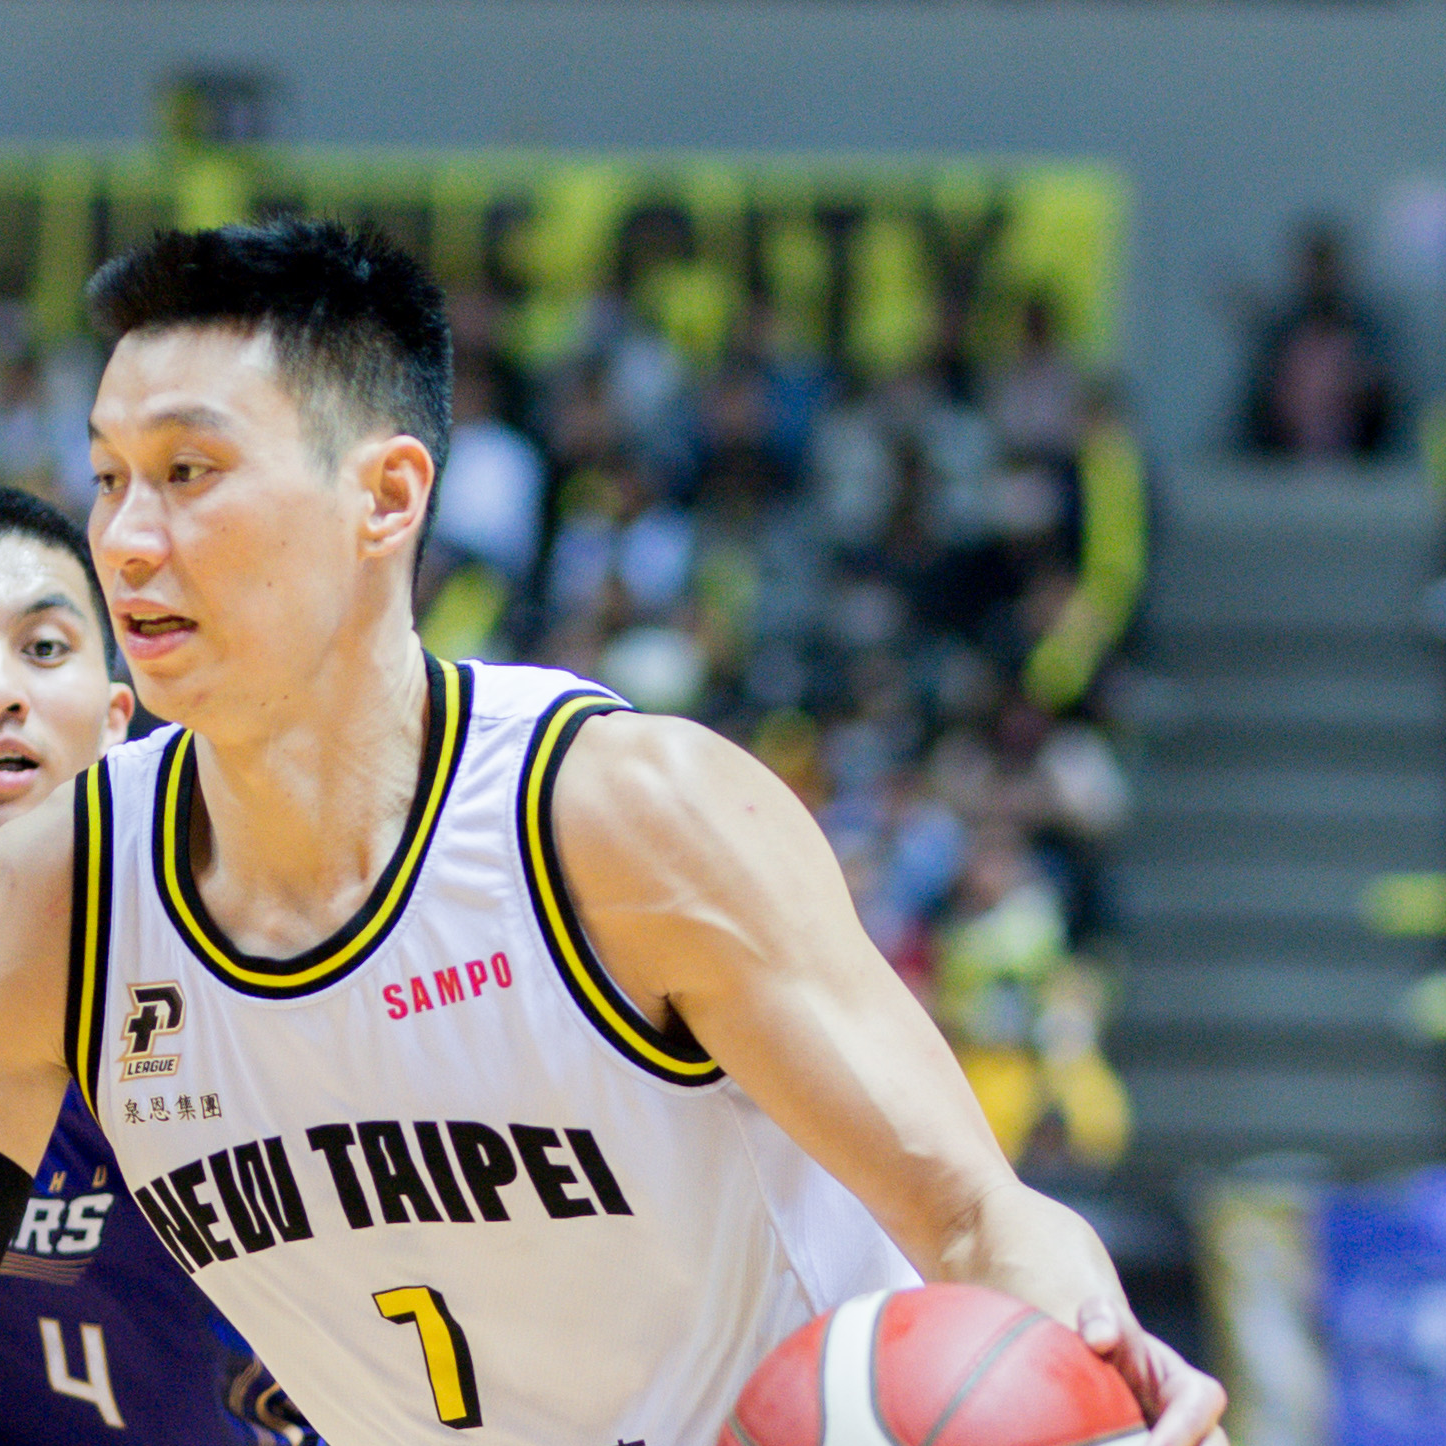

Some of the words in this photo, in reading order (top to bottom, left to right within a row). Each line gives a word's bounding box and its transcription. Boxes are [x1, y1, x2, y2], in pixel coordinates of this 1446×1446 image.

[382, 951, 513, 1020] SAMPO
[124, 1092, 222, 1124] 泉恩集團
[127, 1058, 175, 1076] LEAGUE
[134, 1135, 314, 1275] NEW
[306, 1120, 635, 1230] TAIPEI
[38, 1316, 126, 1429] 4
[372, 1285, 484, 1430] 7
